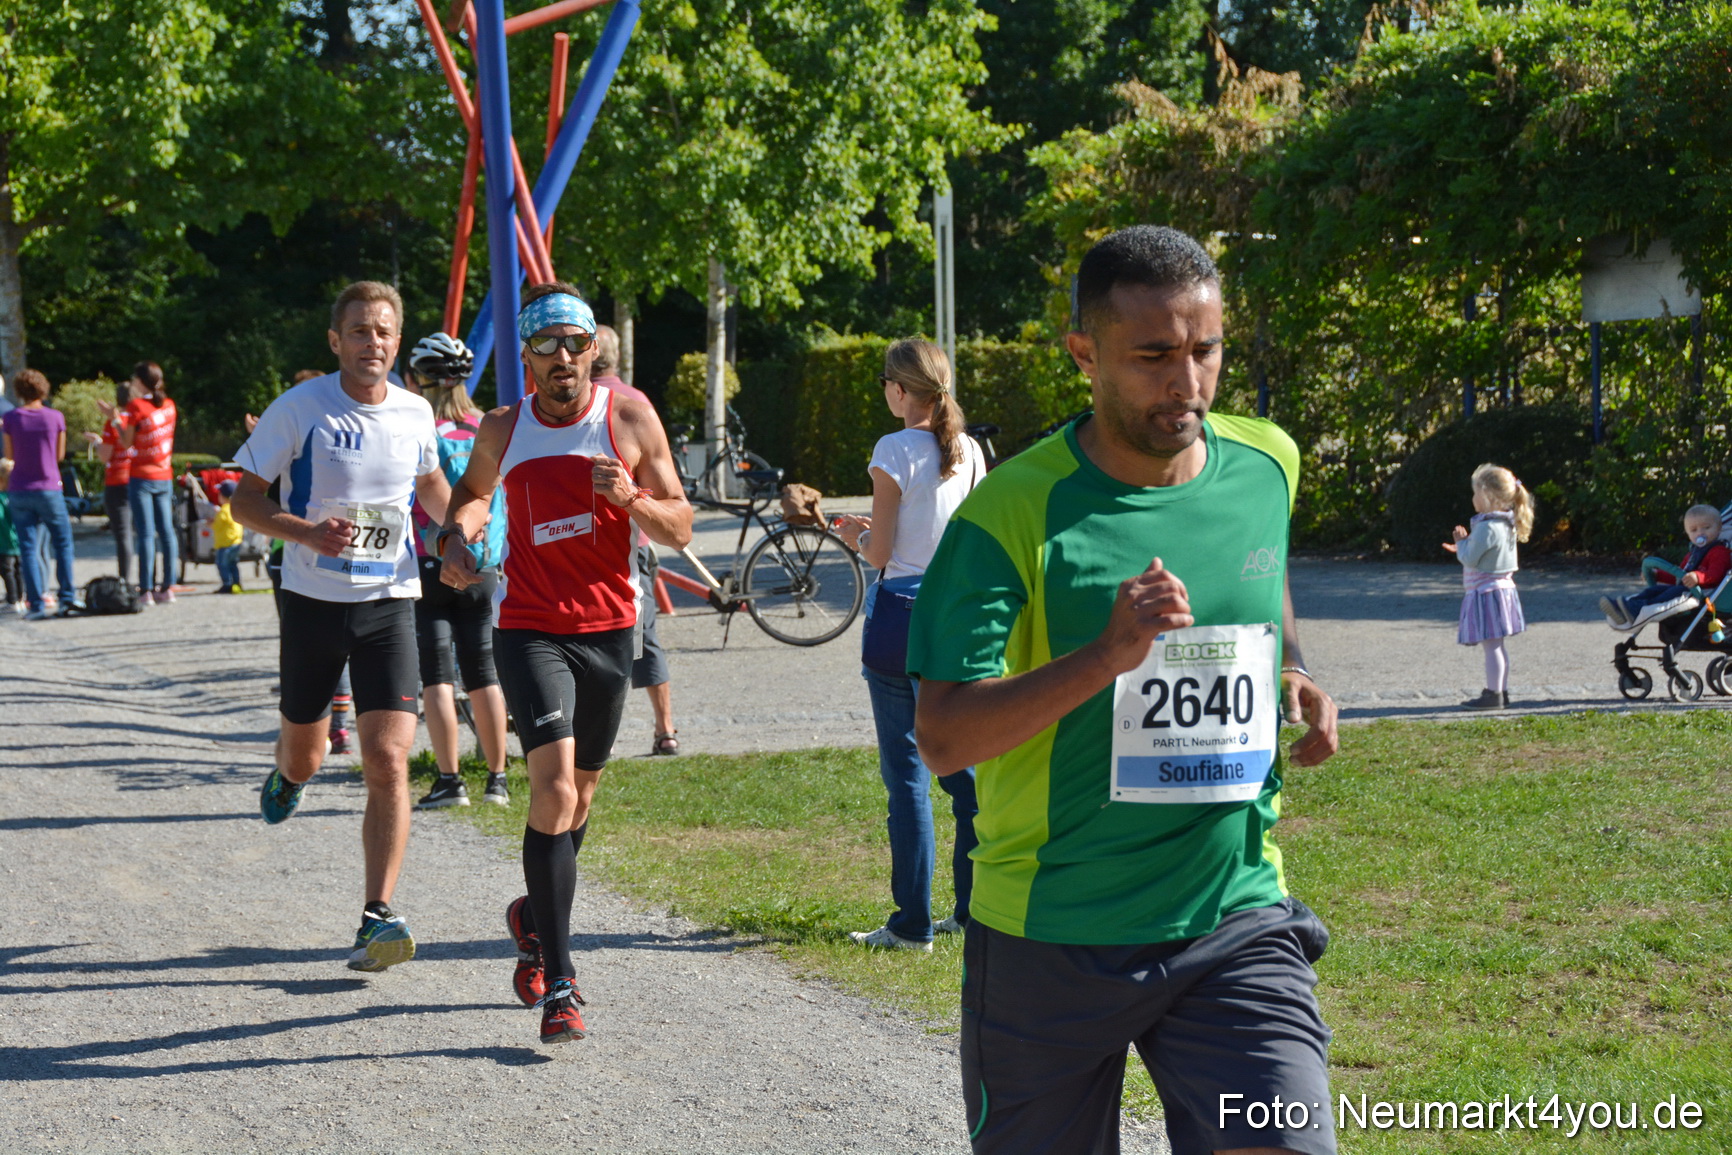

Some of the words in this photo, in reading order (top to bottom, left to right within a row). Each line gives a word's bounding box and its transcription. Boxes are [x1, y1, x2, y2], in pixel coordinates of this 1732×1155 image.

[349, 525, 390, 549] 278
[548, 522, 575, 536] DEHN
[341, 561, 370, 574] Armin
[1241, 545, 1280, 574] AOK
[1165, 641, 1237, 661] BOCK
[1141, 674, 1254, 729] 2640
[1123, 720, 1131, 730] D
[1153, 738, 1188, 748] PARTL
[1191, 736, 1237, 747] Neumarkt
[1158, 760, 1244, 782] Soufiane
